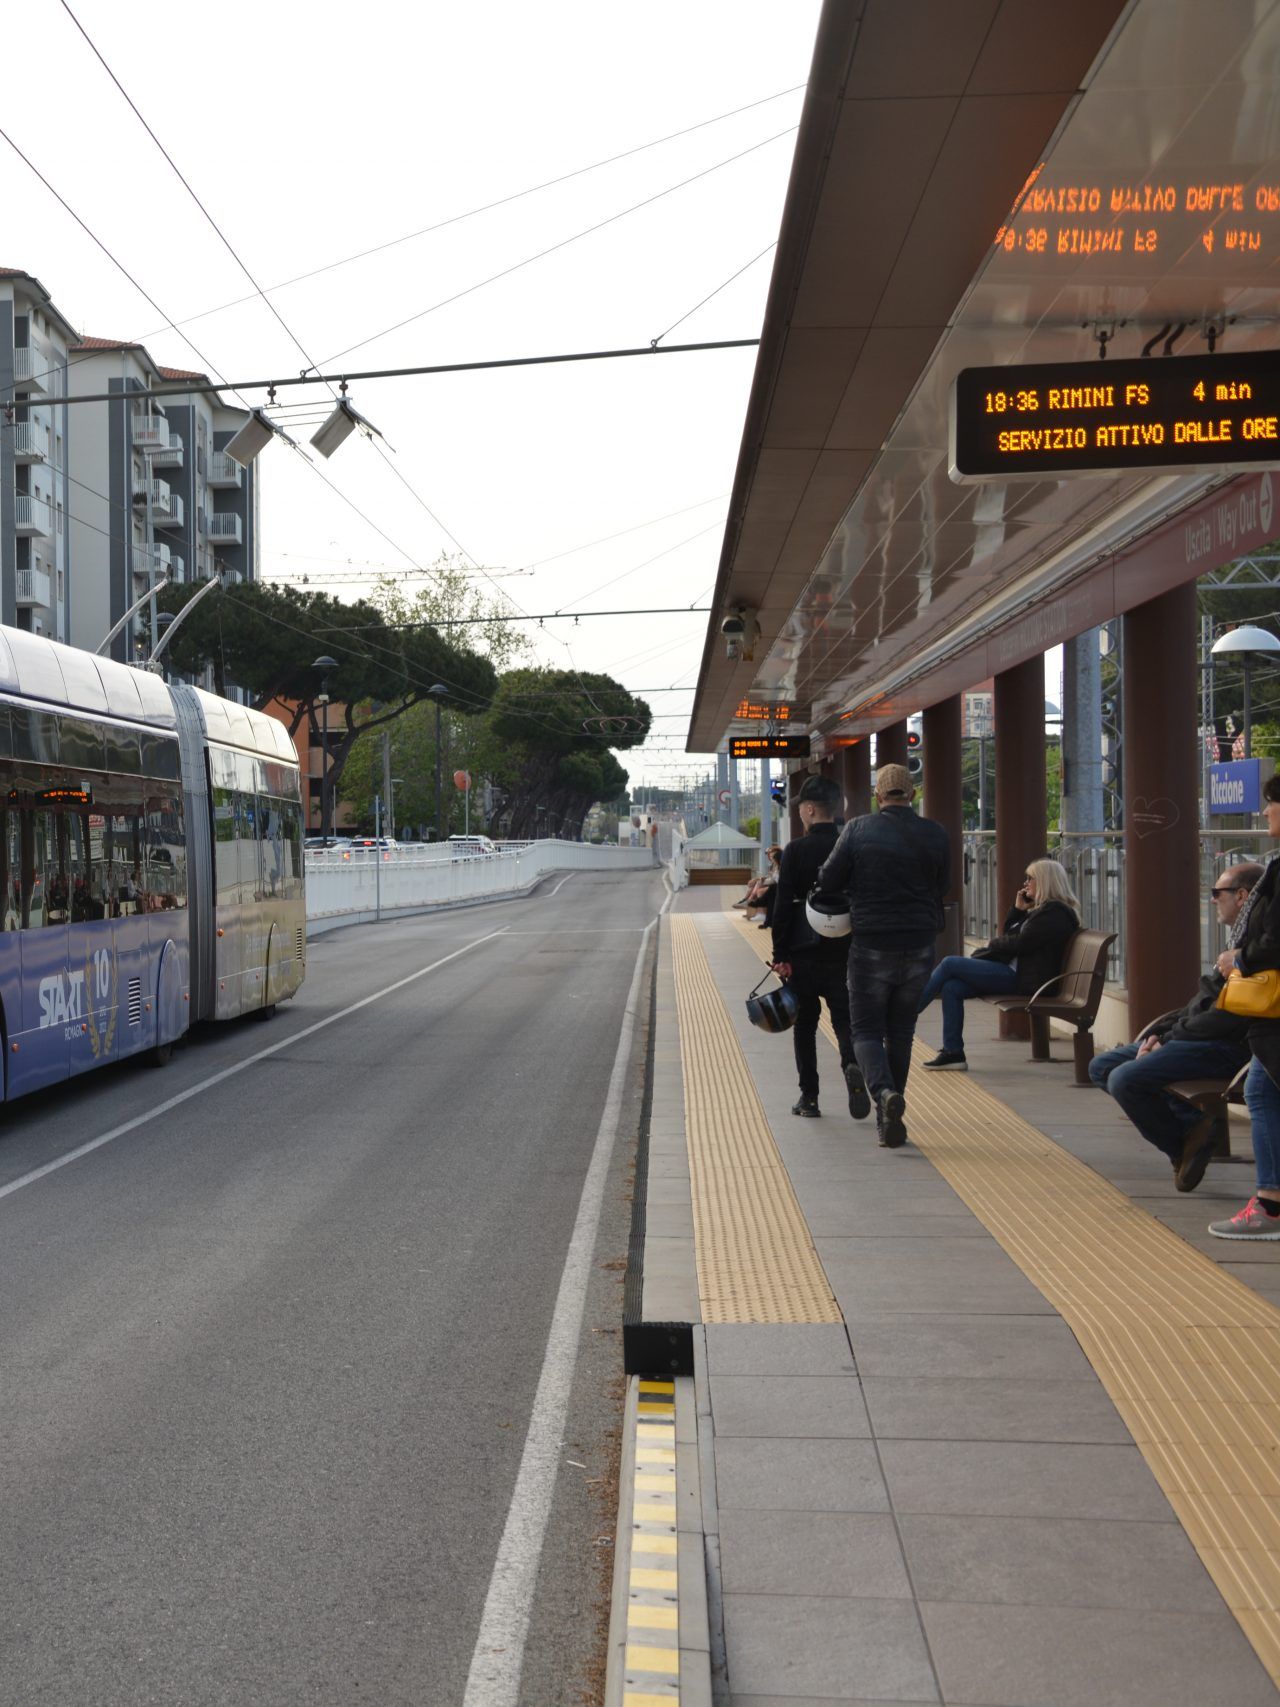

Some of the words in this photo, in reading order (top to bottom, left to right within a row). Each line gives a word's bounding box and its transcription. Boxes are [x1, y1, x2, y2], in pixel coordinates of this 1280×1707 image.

[986, 390, 1039, 413] 18:36
[1049, 386, 1113, 410] RIMINI
[1126, 384, 1149, 406] FS
[1193, 380, 1205, 401] 4
[1215, 381, 1252, 401] min
[998, 427, 1087, 451] SERVIZIO
[1096, 423, 1164, 447] ATTIVO
[1174, 419, 1232, 443] DALLE
[1242, 416, 1278, 440] ORE
[1218, 503, 1238, 550] Way
[1240, 488, 1257, 535] Out
[1211, 772, 1244, 805] Riccione
[94, 949, 109, 999] 10
[39, 968, 84, 1029] START
